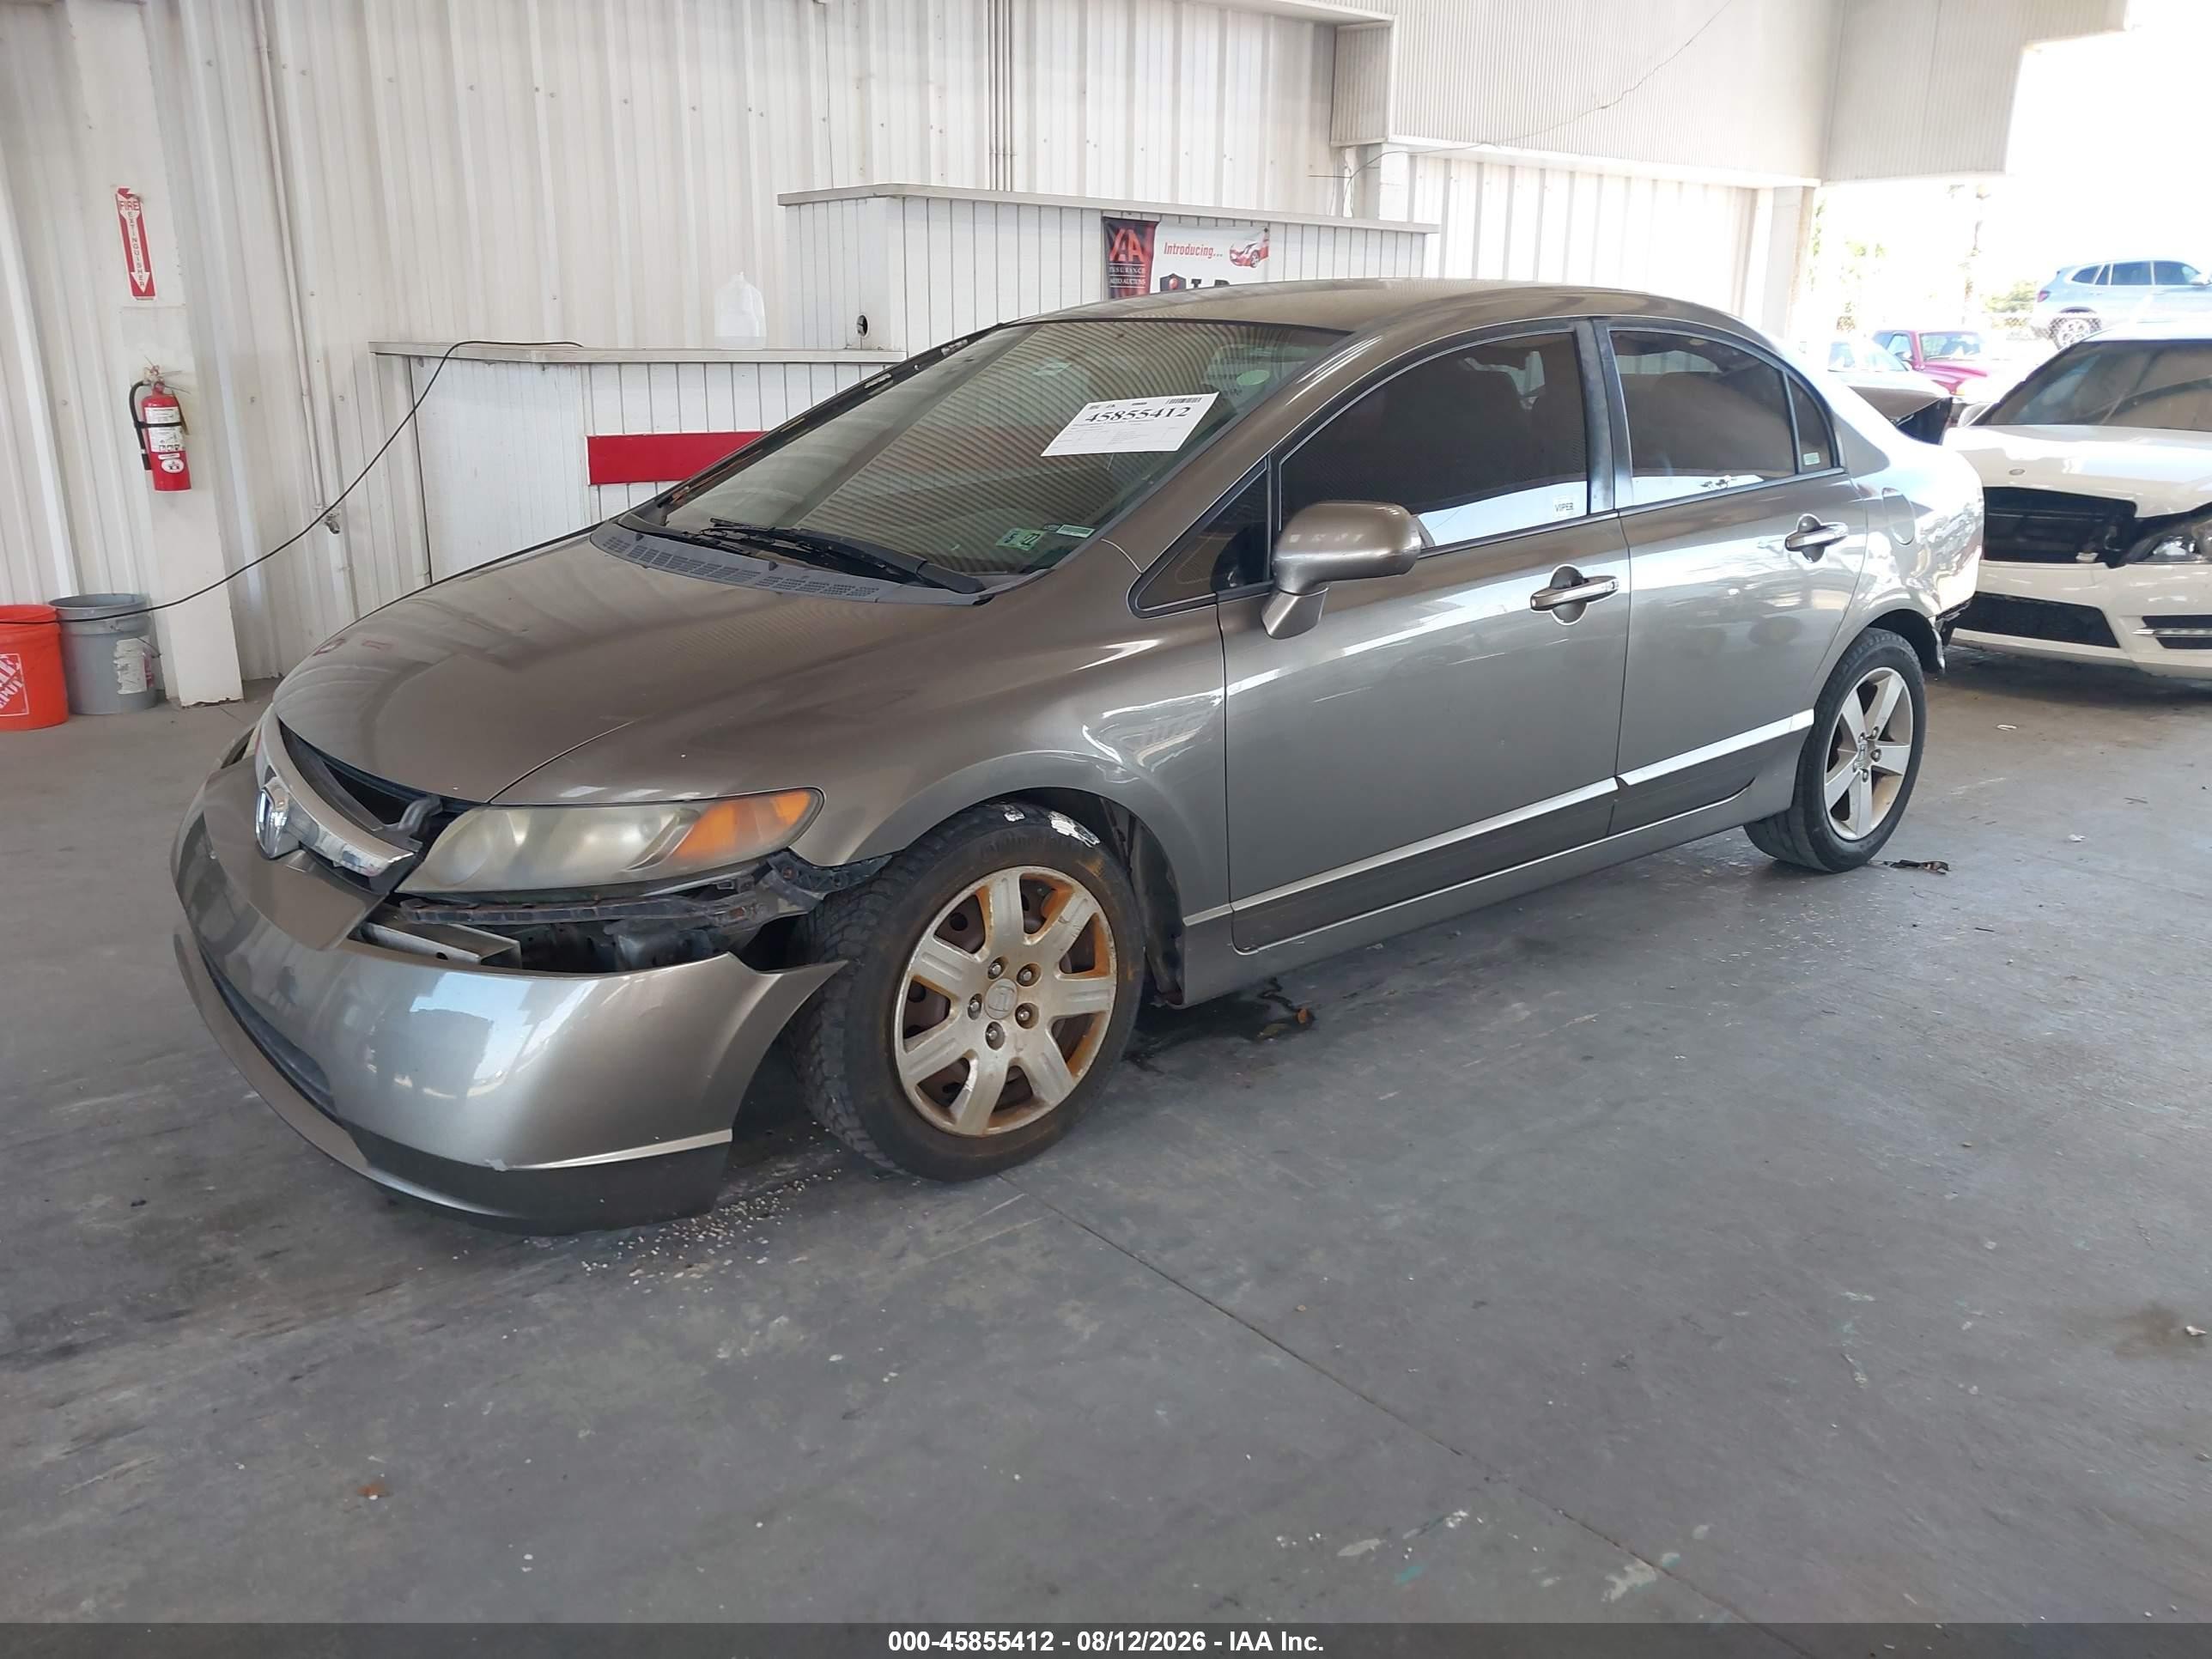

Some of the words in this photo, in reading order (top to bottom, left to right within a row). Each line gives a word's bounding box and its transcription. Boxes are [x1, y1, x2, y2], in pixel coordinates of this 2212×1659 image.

[119, 200, 140, 211] FIRE
[127, 211, 145, 287] EXTINGUISHER
[1164, 242, 1223, 259] Introducing...
[1085, 406, 1191, 422] 45855412
